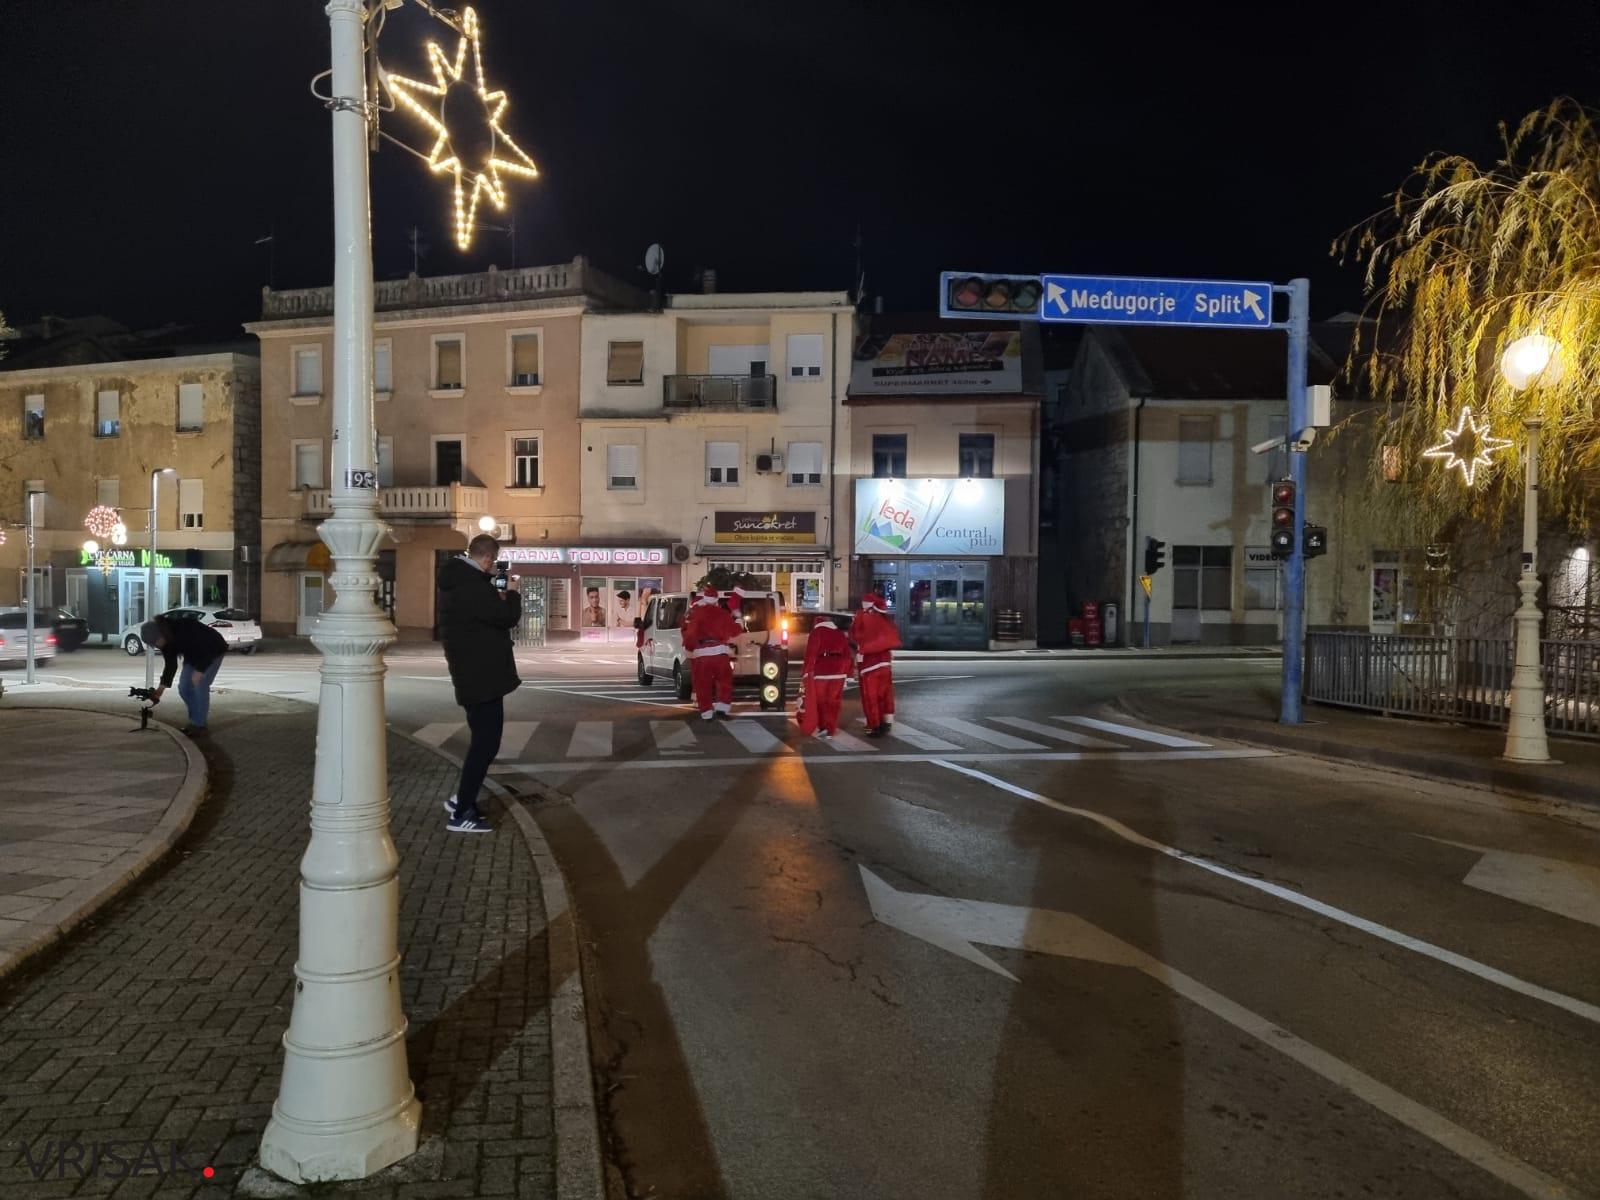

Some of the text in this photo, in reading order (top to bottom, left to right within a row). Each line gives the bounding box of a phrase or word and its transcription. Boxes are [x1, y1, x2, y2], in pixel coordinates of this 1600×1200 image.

[1071, 289, 1241, 318] Međugorje Split
[732, 514, 797, 531] suncokret
[879, 499, 916, 531] leda
[935, 527, 988, 539] Central
[969, 535, 997, 550] pub
[500, 550, 661, 562] ATARNA TONI GOLD
